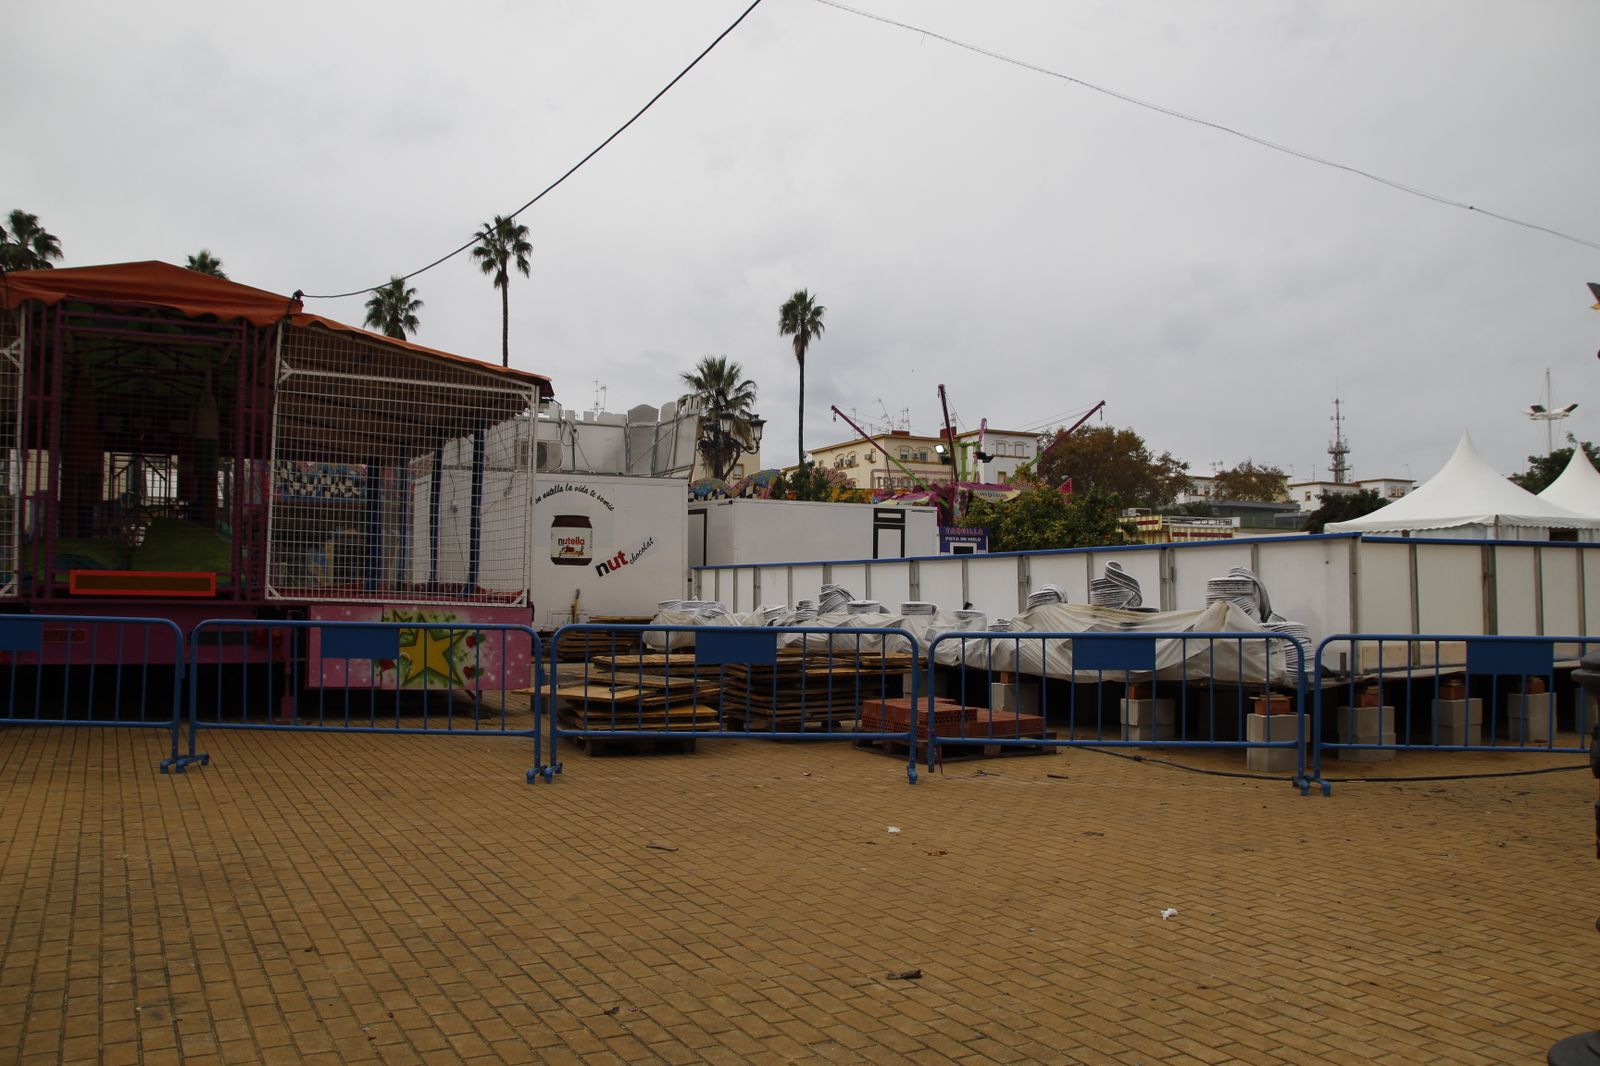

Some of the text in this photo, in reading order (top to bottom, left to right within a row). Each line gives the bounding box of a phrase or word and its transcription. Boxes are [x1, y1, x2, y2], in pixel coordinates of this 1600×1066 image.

[543, 484, 563, 499] nutella
[565, 482, 573, 492] la
[574, 484, 589, 494] vida
[589, 489, 597, 498] te
[558, 537, 585, 546] nutella
[595, 550, 629, 577] nut
